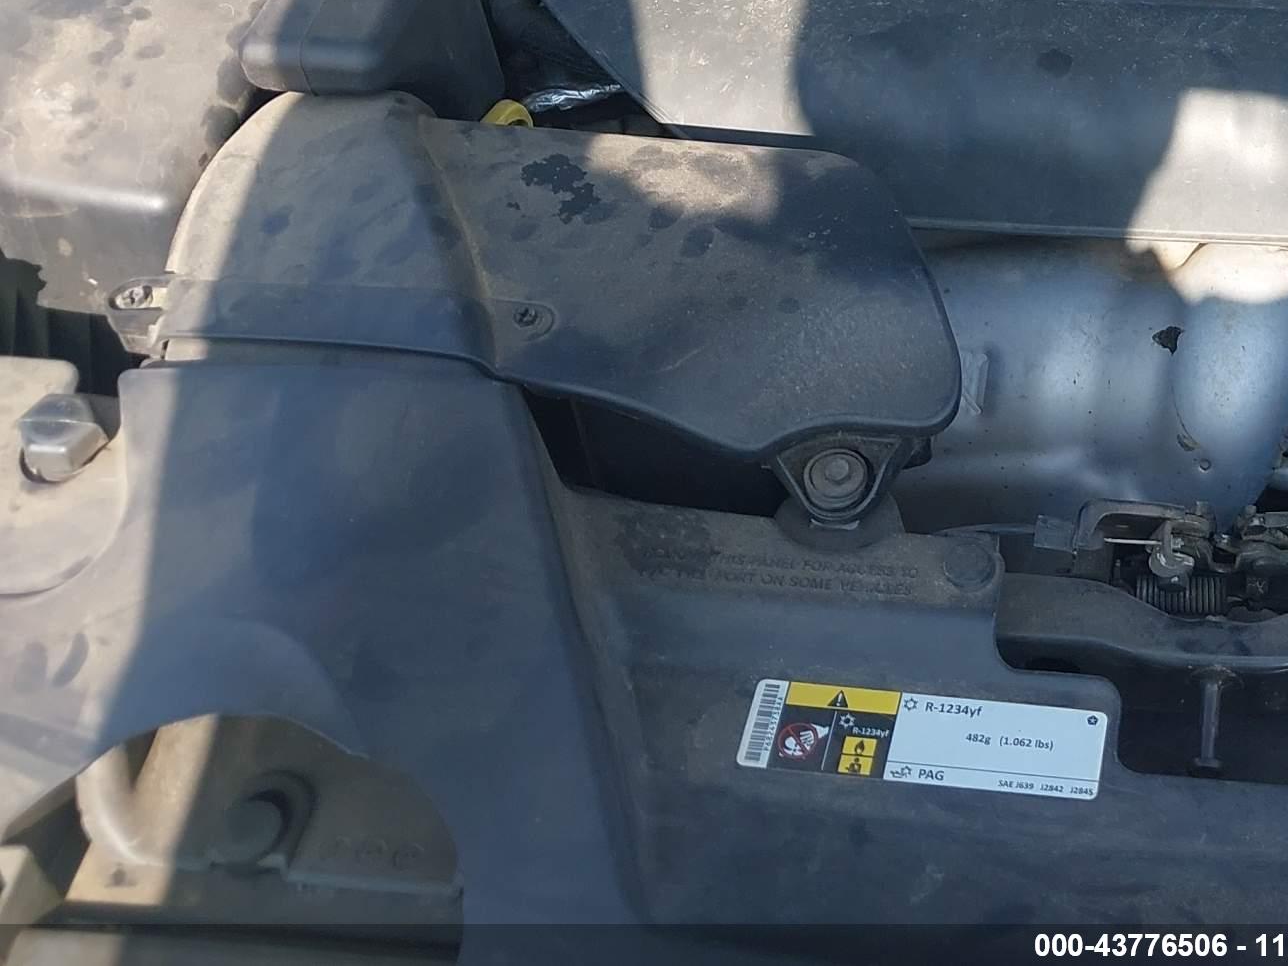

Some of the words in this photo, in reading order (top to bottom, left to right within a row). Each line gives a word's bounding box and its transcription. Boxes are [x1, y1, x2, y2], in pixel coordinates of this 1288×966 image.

[803, 559, 833, 572] FOR
[760, 574, 786, 587] ON
[789, 577, 833, 591] SOME
[925, 701, 983, 718] R-1234yf
[853, 725, 890, 737] R-1234yf
[965, 733, 991, 745] 482g
[999, 735, 1032, 748] (1.062
[1034, 737, 1054, 752] lbs)
[918, 768, 945, 781] PAG
[998, 779, 1013, 789] SAE
[1015, 781, 1034, 790] J639
